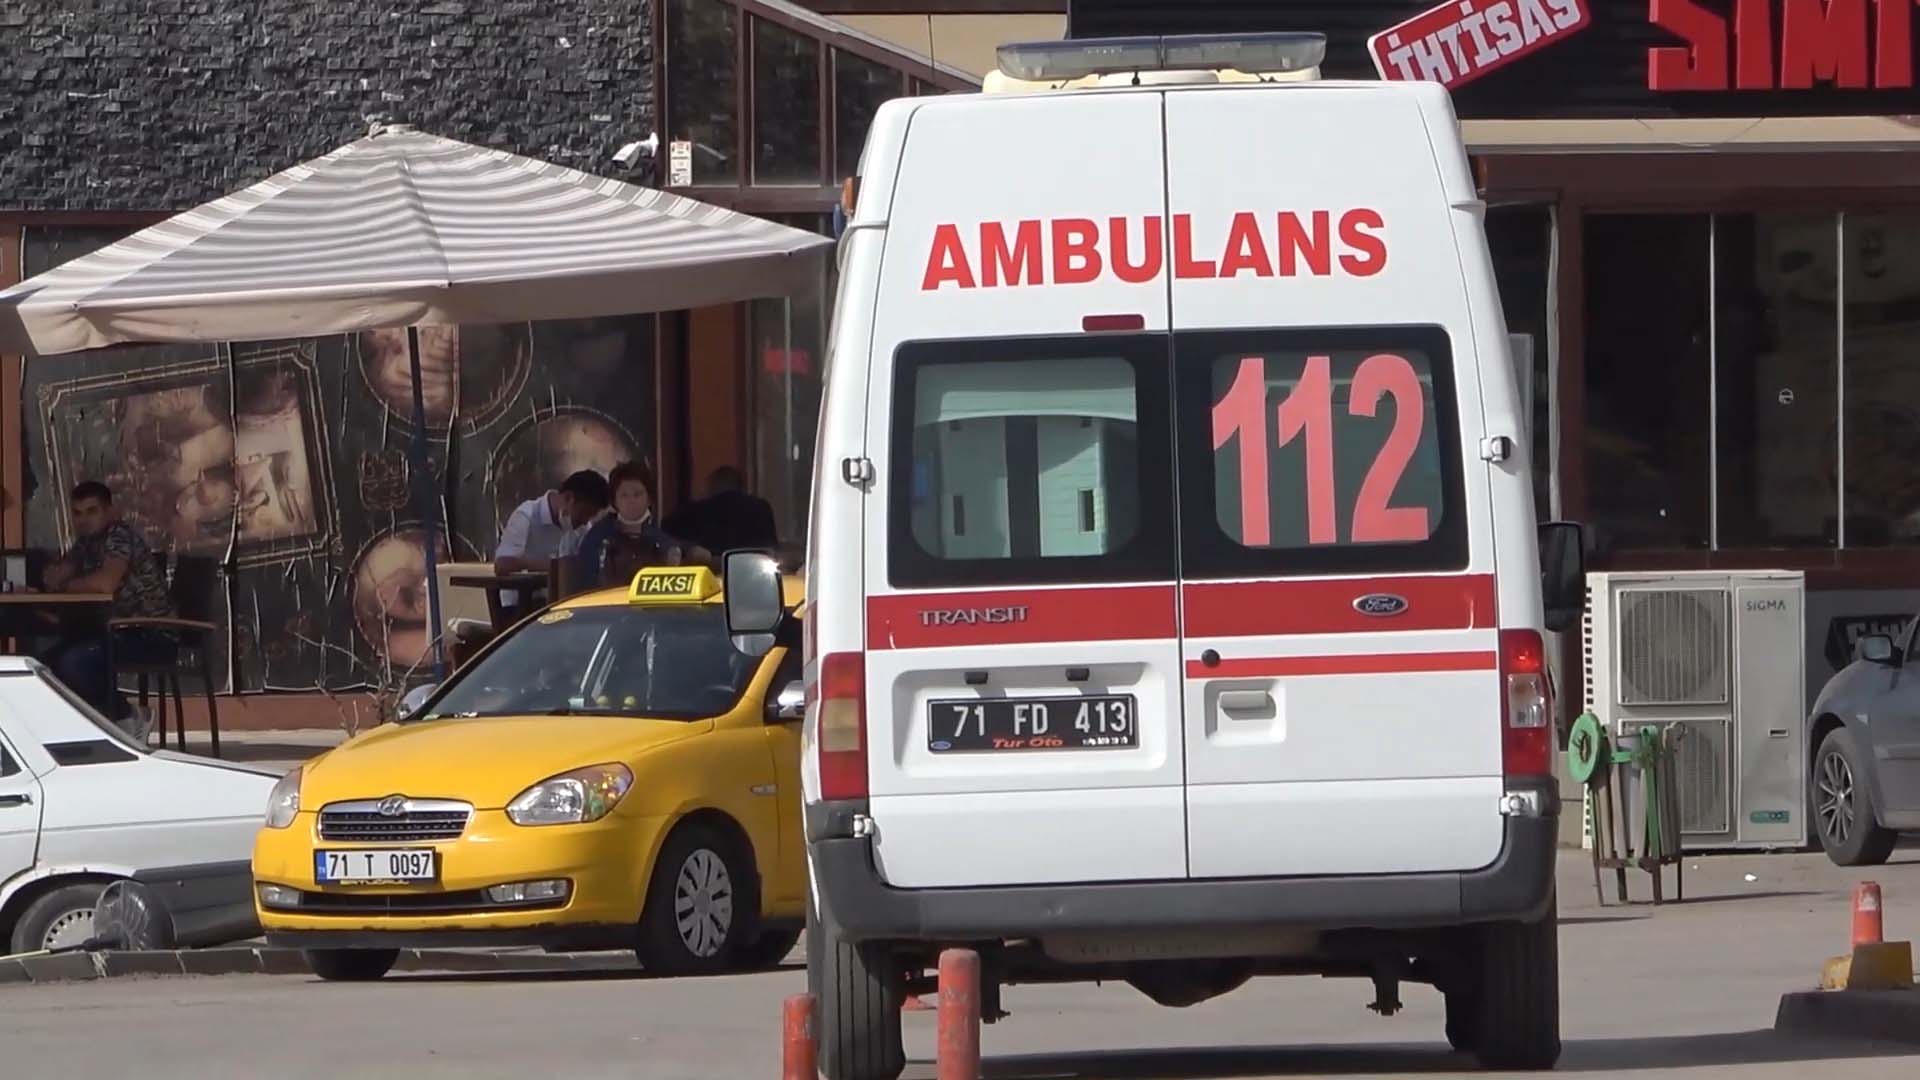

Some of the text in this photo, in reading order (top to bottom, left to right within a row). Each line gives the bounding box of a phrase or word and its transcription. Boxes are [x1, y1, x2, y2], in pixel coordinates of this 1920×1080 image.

[921, 208, 1388, 290] AMBULANS
[1212, 354, 1430, 546] 112
[918, 605, 1029, 625] TRANSIT
[1746, 600, 1786, 611] SIGMA
[953, 702, 1126, 737] 71 FD 413
[329, 853, 430, 877] 71 T 0097
